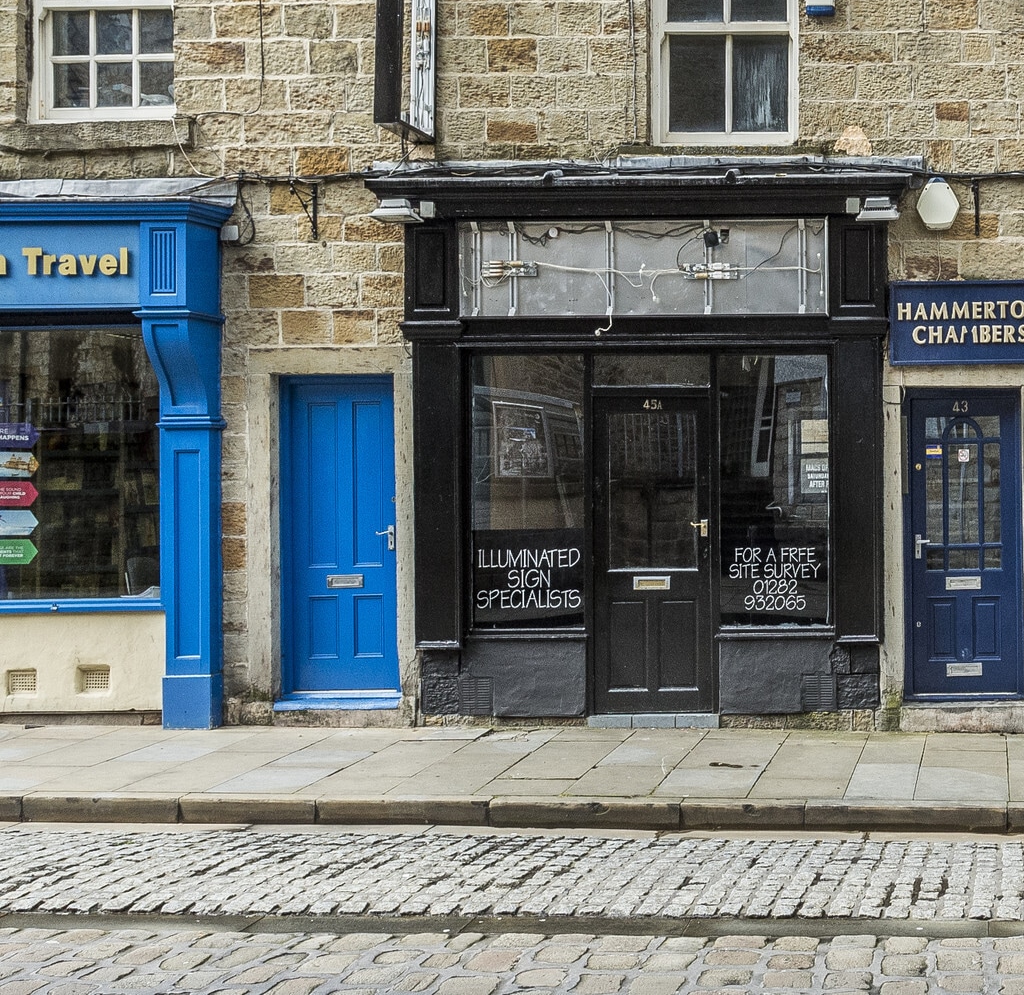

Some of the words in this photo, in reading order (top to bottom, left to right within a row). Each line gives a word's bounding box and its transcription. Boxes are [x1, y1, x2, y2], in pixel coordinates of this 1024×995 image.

[22, 247, 128, 276] Travel
[642, 399, 663, 410] 45A
[952, 400, 969, 413] 43
[477, 548, 581, 568] ILLUMINATED
[735, 547, 762, 563] FOR
[765, 547, 777, 563] A
[507, 568, 551, 588] SIGN
[728, 563, 760, 579] SITE
[763, 563, 822, 579] SURVEY
[753, 579, 798, 595] 01282
[476, 589, 582, 609] SPECIALISTS
[744, 595, 807, 611] 932065
